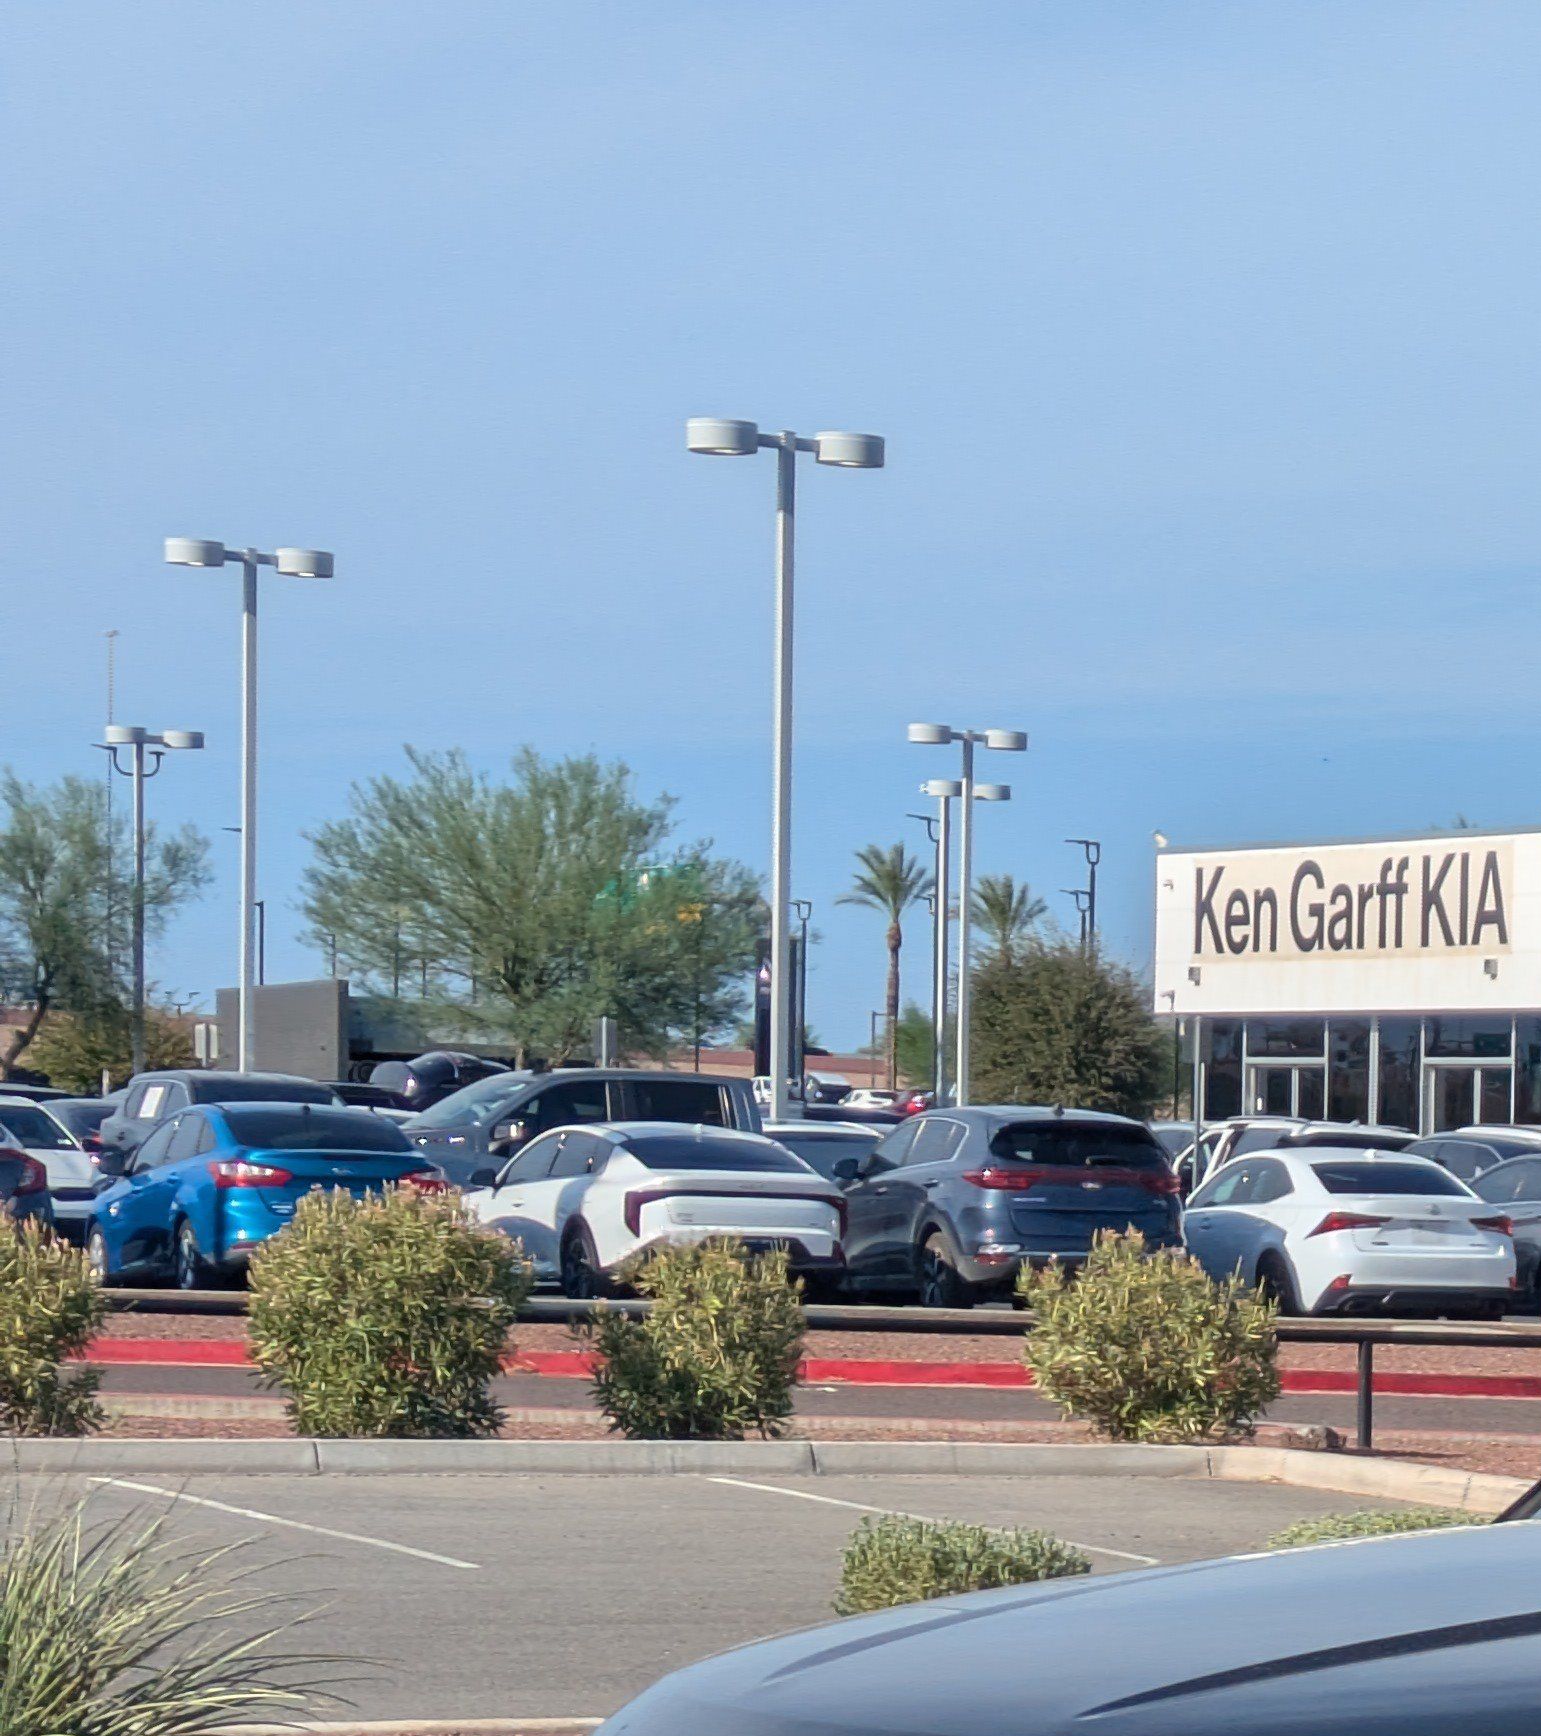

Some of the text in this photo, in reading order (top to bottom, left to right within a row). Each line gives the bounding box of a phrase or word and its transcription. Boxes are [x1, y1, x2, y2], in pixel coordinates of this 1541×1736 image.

[1194, 851, 1508, 954] Ken Garff KIA
